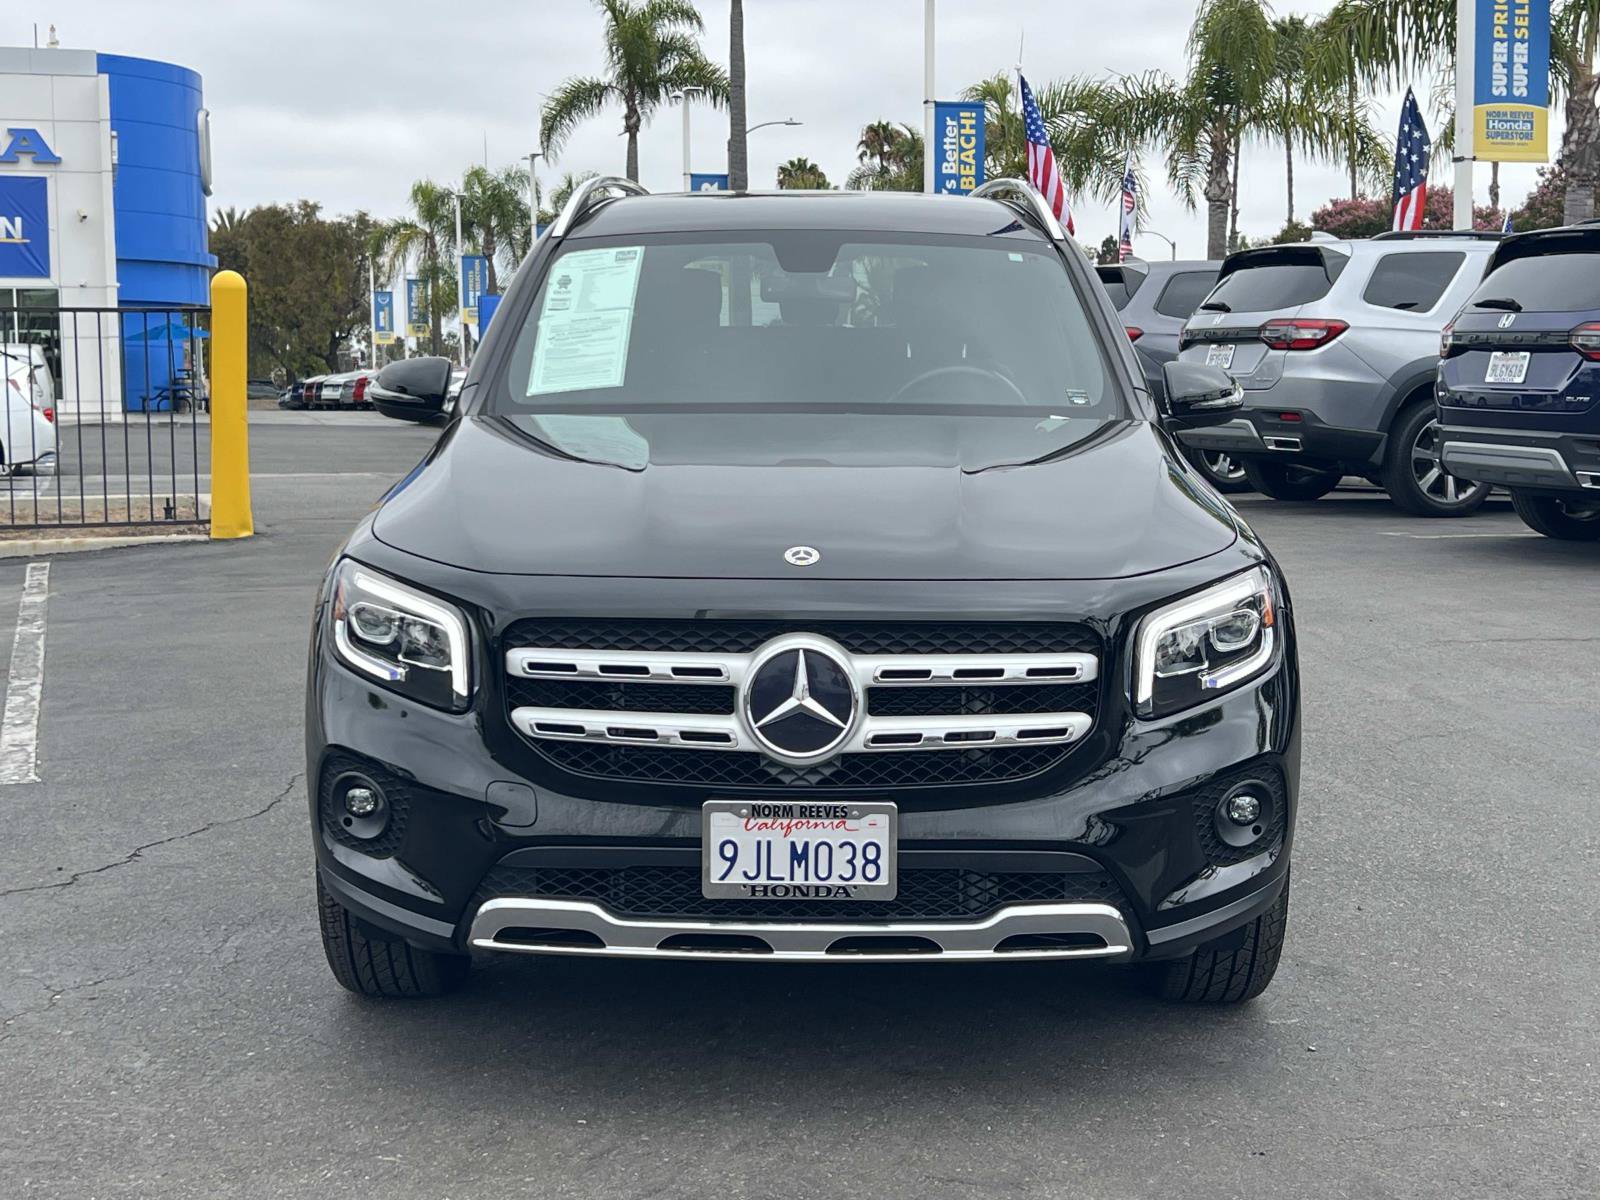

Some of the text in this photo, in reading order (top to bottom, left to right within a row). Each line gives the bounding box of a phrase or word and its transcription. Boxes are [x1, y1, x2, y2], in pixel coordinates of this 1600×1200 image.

[1492, 41, 1508, 97] SUPER
[1513, 42, 1529, 97] SUPER
[1486, 131, 1534, 141] SUPERSTORE
[1488, 119, 1532, 130] Honda
[942, 117, 957, 174] Better
[960, 112, 976, 190] BEACH!
[744, 817, 860, 838] California
[751, 805, 848, 818] NORM REEVES
[718, 839, 882, 882] 9JLM038
[750, 884, 852, 898] HONDA
